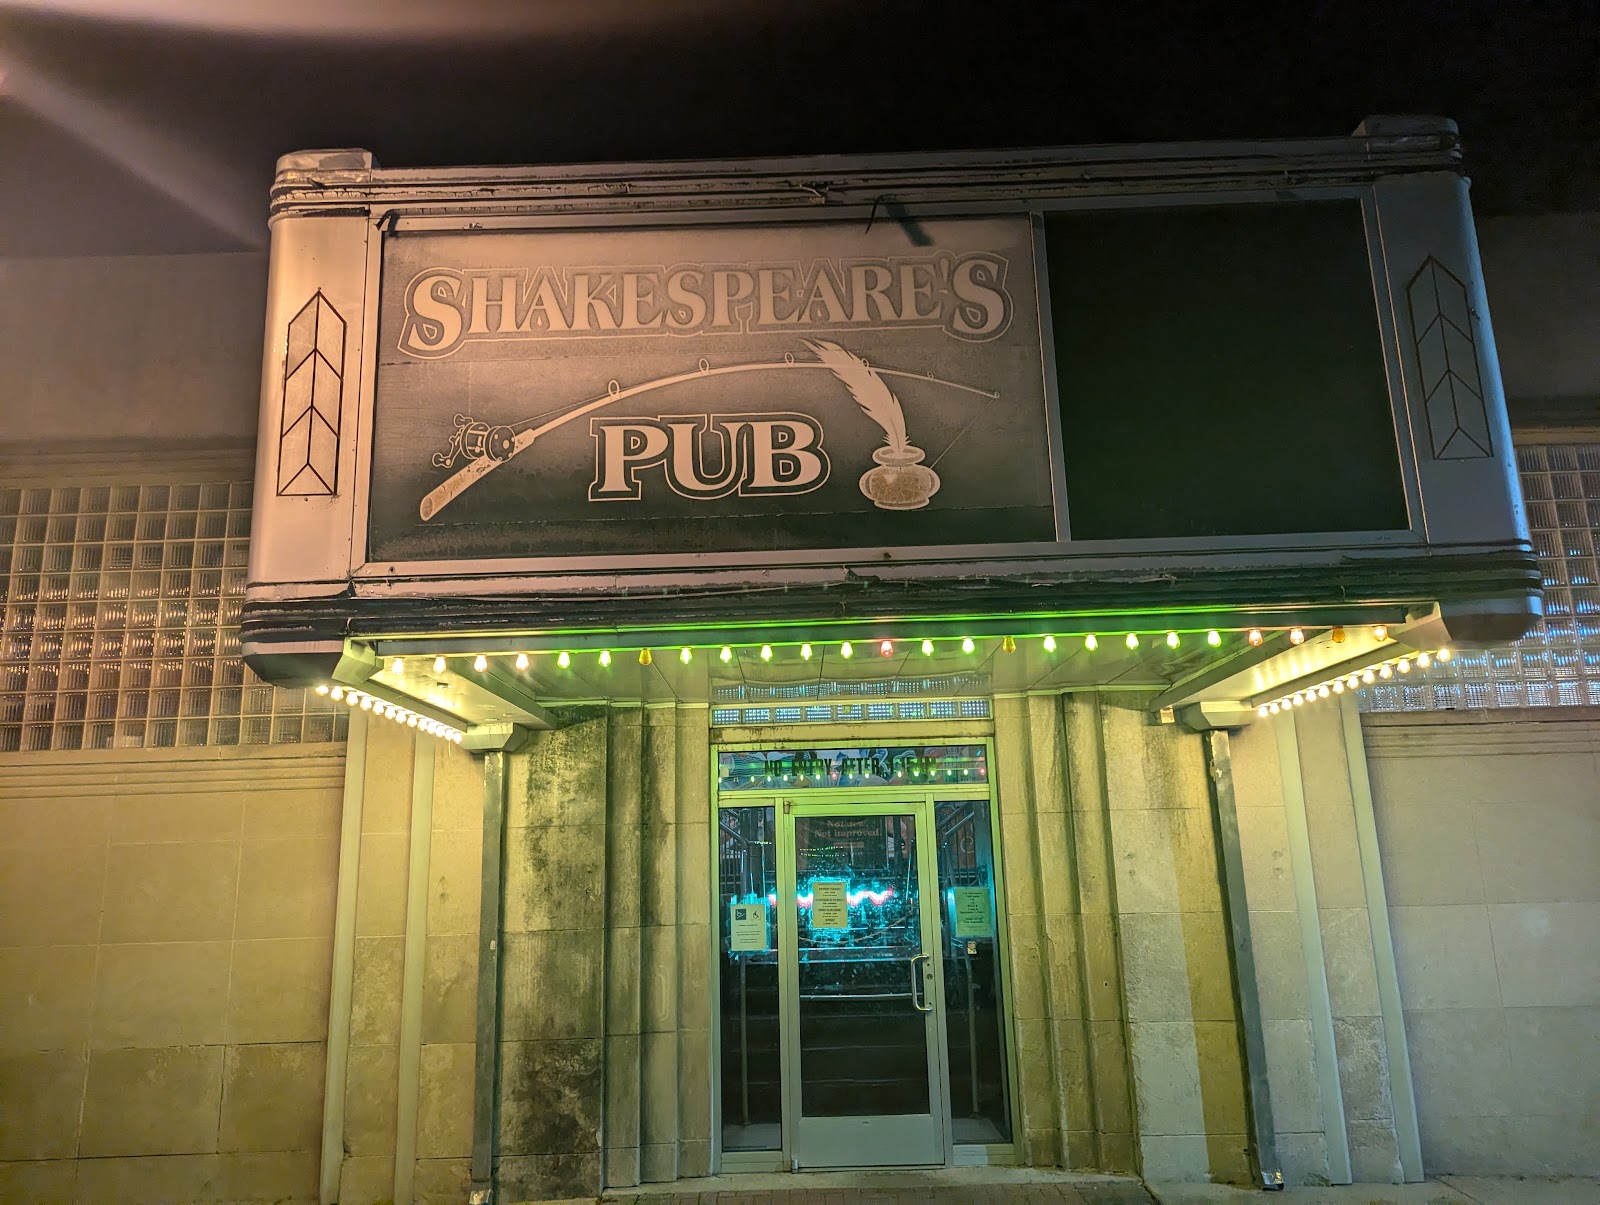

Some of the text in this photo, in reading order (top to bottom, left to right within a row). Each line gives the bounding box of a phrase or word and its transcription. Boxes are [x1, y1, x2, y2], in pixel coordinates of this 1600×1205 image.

[406, 255, 1008, 354] SHAKESPEARE'S
[596, 417, 826, 497] PUB
[764, 759, 783, 777] NO
[791, 758, 832, 776] ENTRY
[841, 757, 880, 775] AFTER
[815, 827, 882, 839] Not improved.
